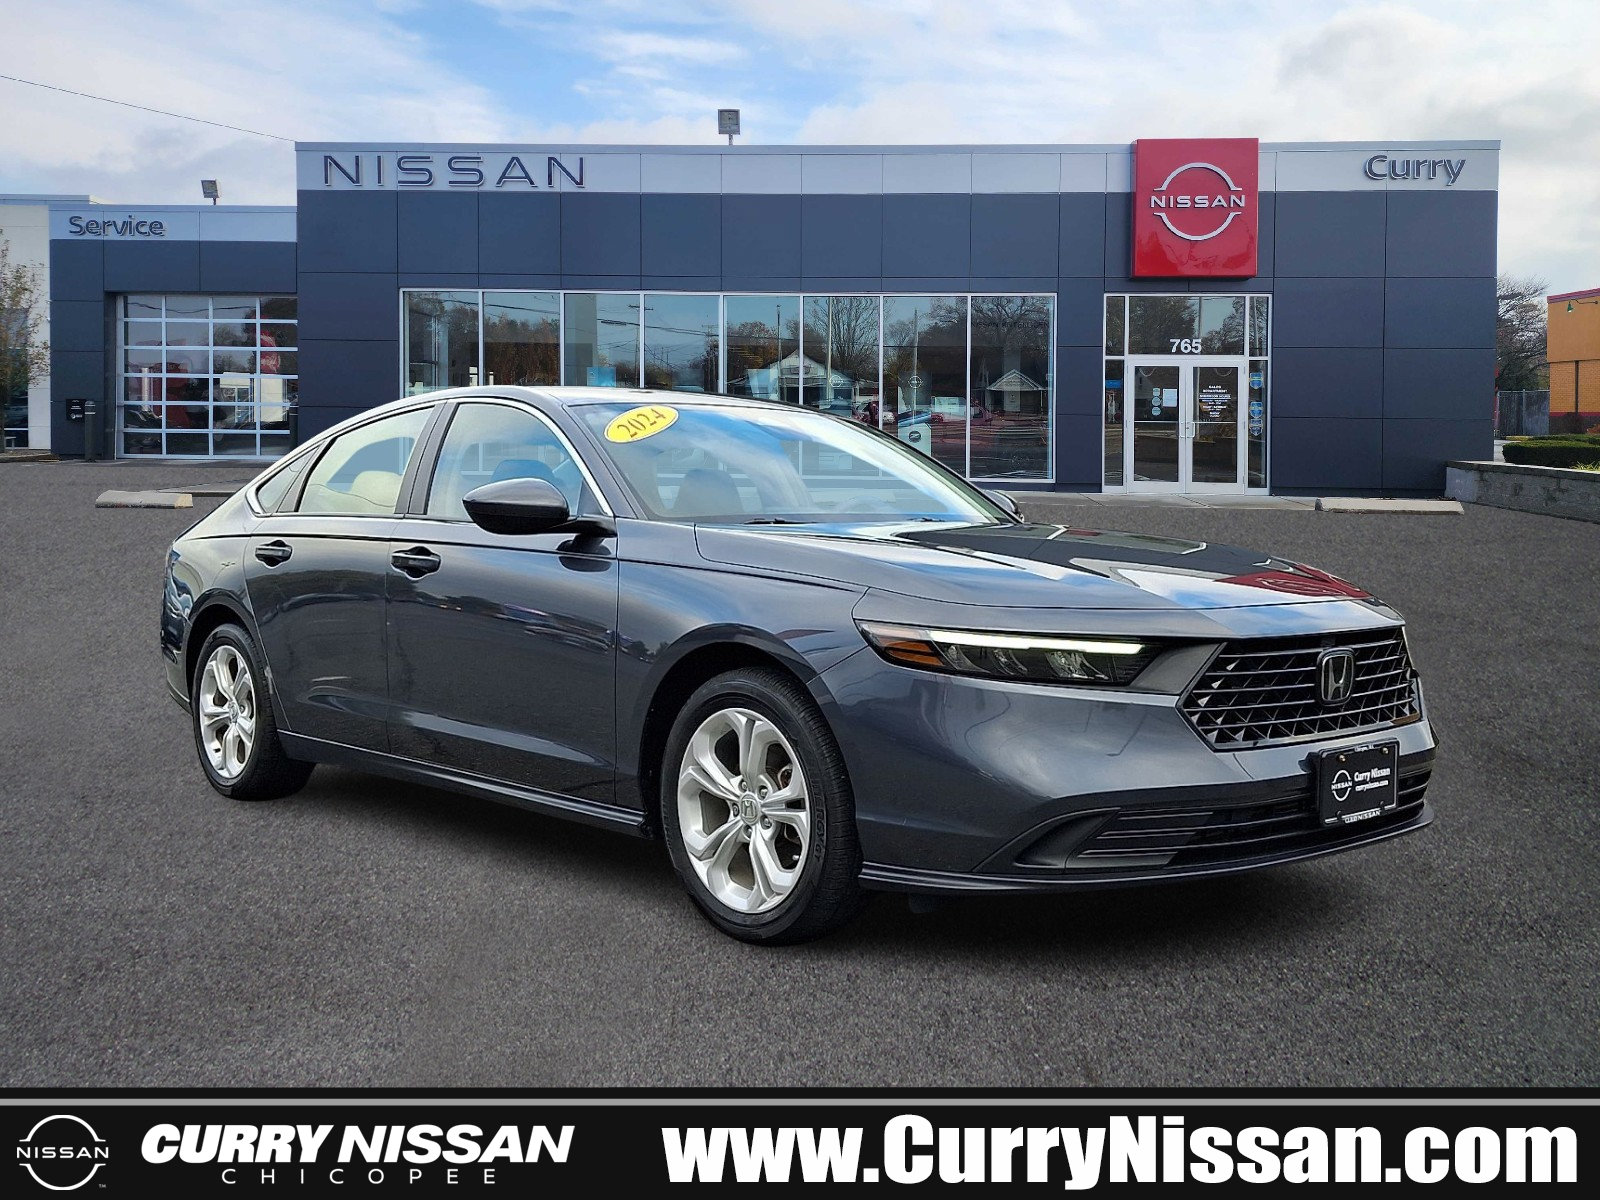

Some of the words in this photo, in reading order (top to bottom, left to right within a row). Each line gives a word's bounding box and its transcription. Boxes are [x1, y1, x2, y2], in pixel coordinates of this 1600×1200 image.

[323, 155, 585, 188] NISSAN
[1364, 154, 1466, 186] Curry
[1150, 194, 1246, 208] NISSAN
[69, 214, 165, 236] Service
[1169, 338, 1202, 353] 765
[617, 408, 666, 438] 2024
[1354, 771, 1371, 782] Curry
[1371, 767, 1391, 779] Nissan
[1331, 780, 1353, 791] NISSAN
